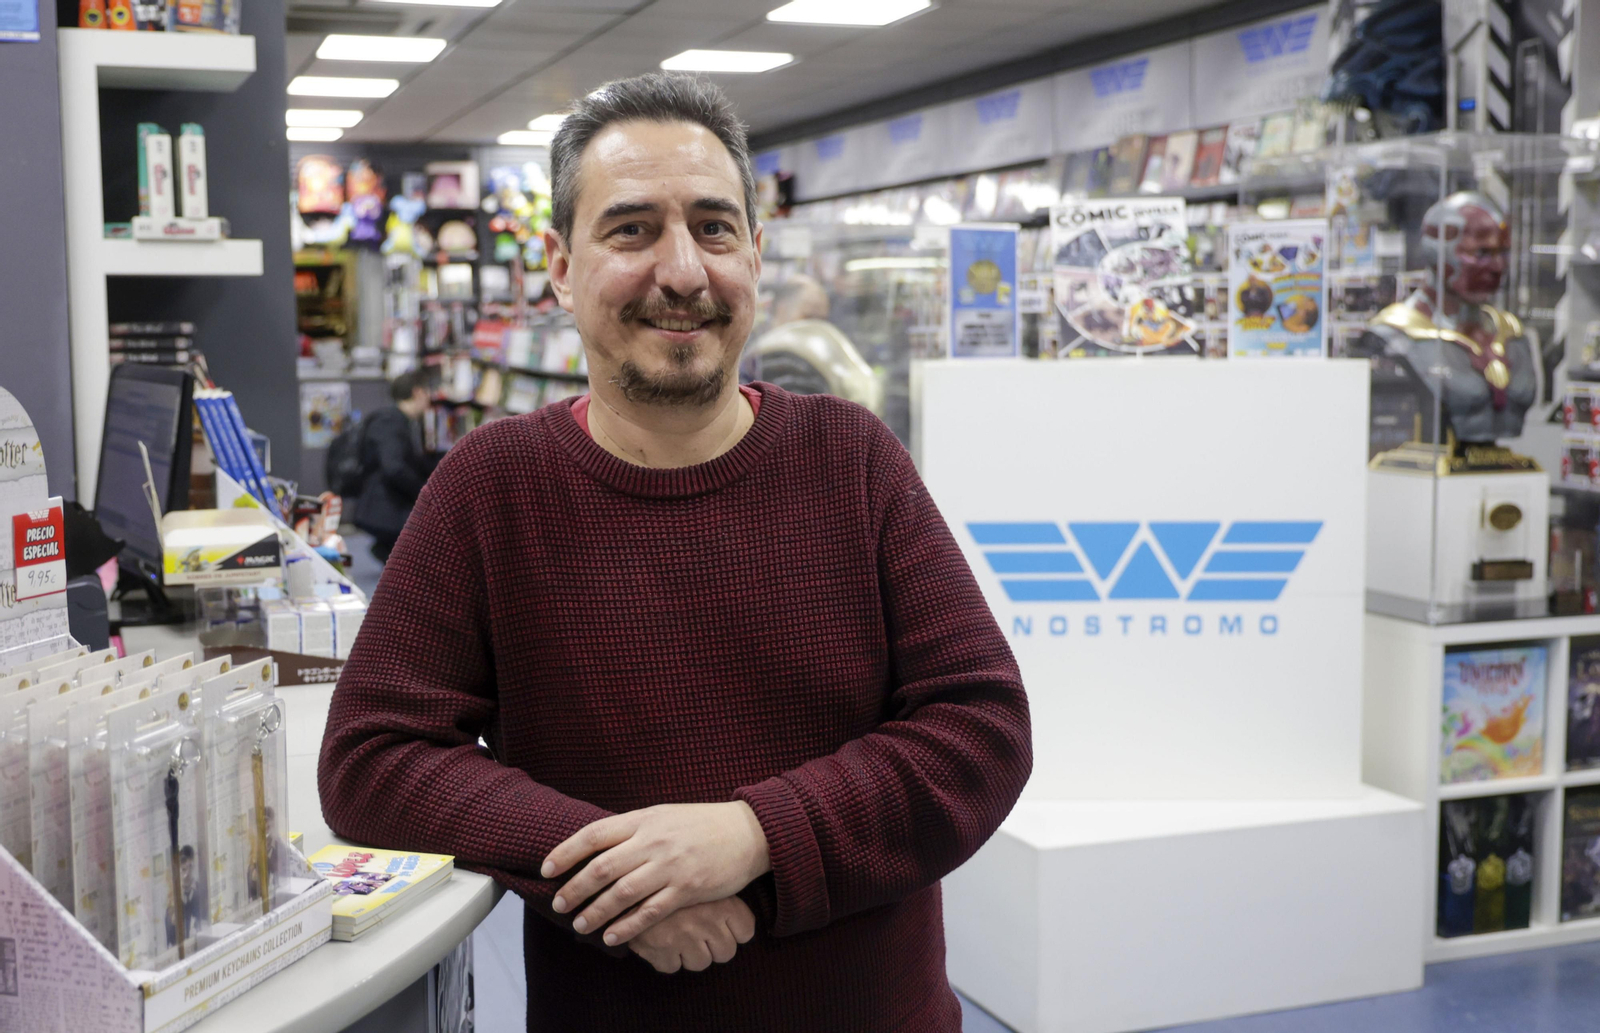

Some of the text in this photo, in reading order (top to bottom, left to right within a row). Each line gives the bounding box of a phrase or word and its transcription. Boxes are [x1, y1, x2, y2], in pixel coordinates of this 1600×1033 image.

[26, 525, 55, 543] PRECIO
[23, 542, 59, 561] ESPECIAL
[1013, 615, 1279, 636] NOSTROMO
[184, 921, 303, 1003] PREMIUM KEYCHAINS COLLECTION
